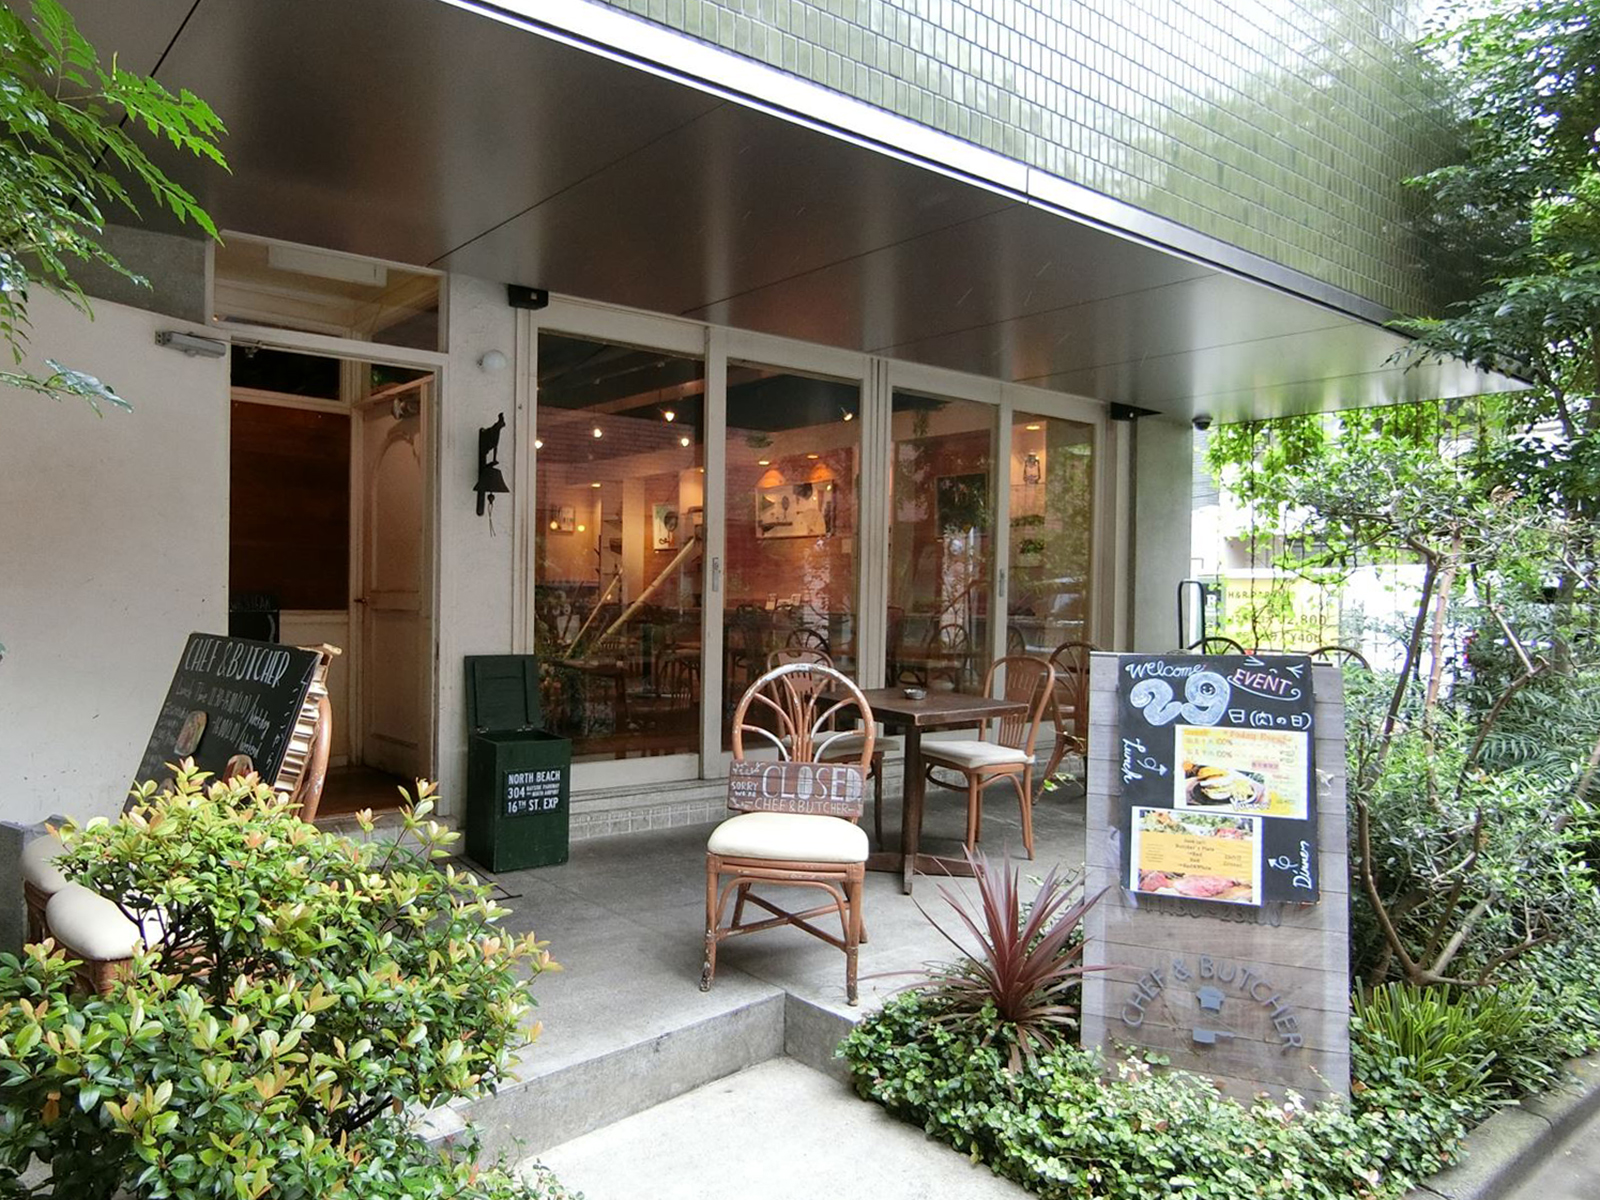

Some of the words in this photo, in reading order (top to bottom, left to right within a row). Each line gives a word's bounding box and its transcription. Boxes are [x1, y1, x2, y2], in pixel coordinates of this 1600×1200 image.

[184, 638, 222, 673] CHEF
[227, 643, 291, 688] BUTCHER
[1125, 660, 1205, 679] Welcome
[1232, 668, 1293, 695] EVENT
[1130, 671, 1231, 727] 29
[1121, 738, 1146, 785] Lunch
[508, 772, 534, 785] NORTH
[536, 770, 560, 783] BEACH
[731, 780, 758, 791] SORRY
[762, 765, 863, 802] CLOSED
[507, 786, 525, 799] 304
[528, 798, 542, 811] ST.
[543, 797, 559, 810] EXP
[755, 797, 787, 811] CHEF
[796, 800, 850, 814] BUTCHER
[1292, 840, 1313, 890] Dinner
[1121, 967, 1166, 1028] CHEF
[1172, 958, 1193, 982] &
[1199, 954, 1304, 1049] BUTCHER
